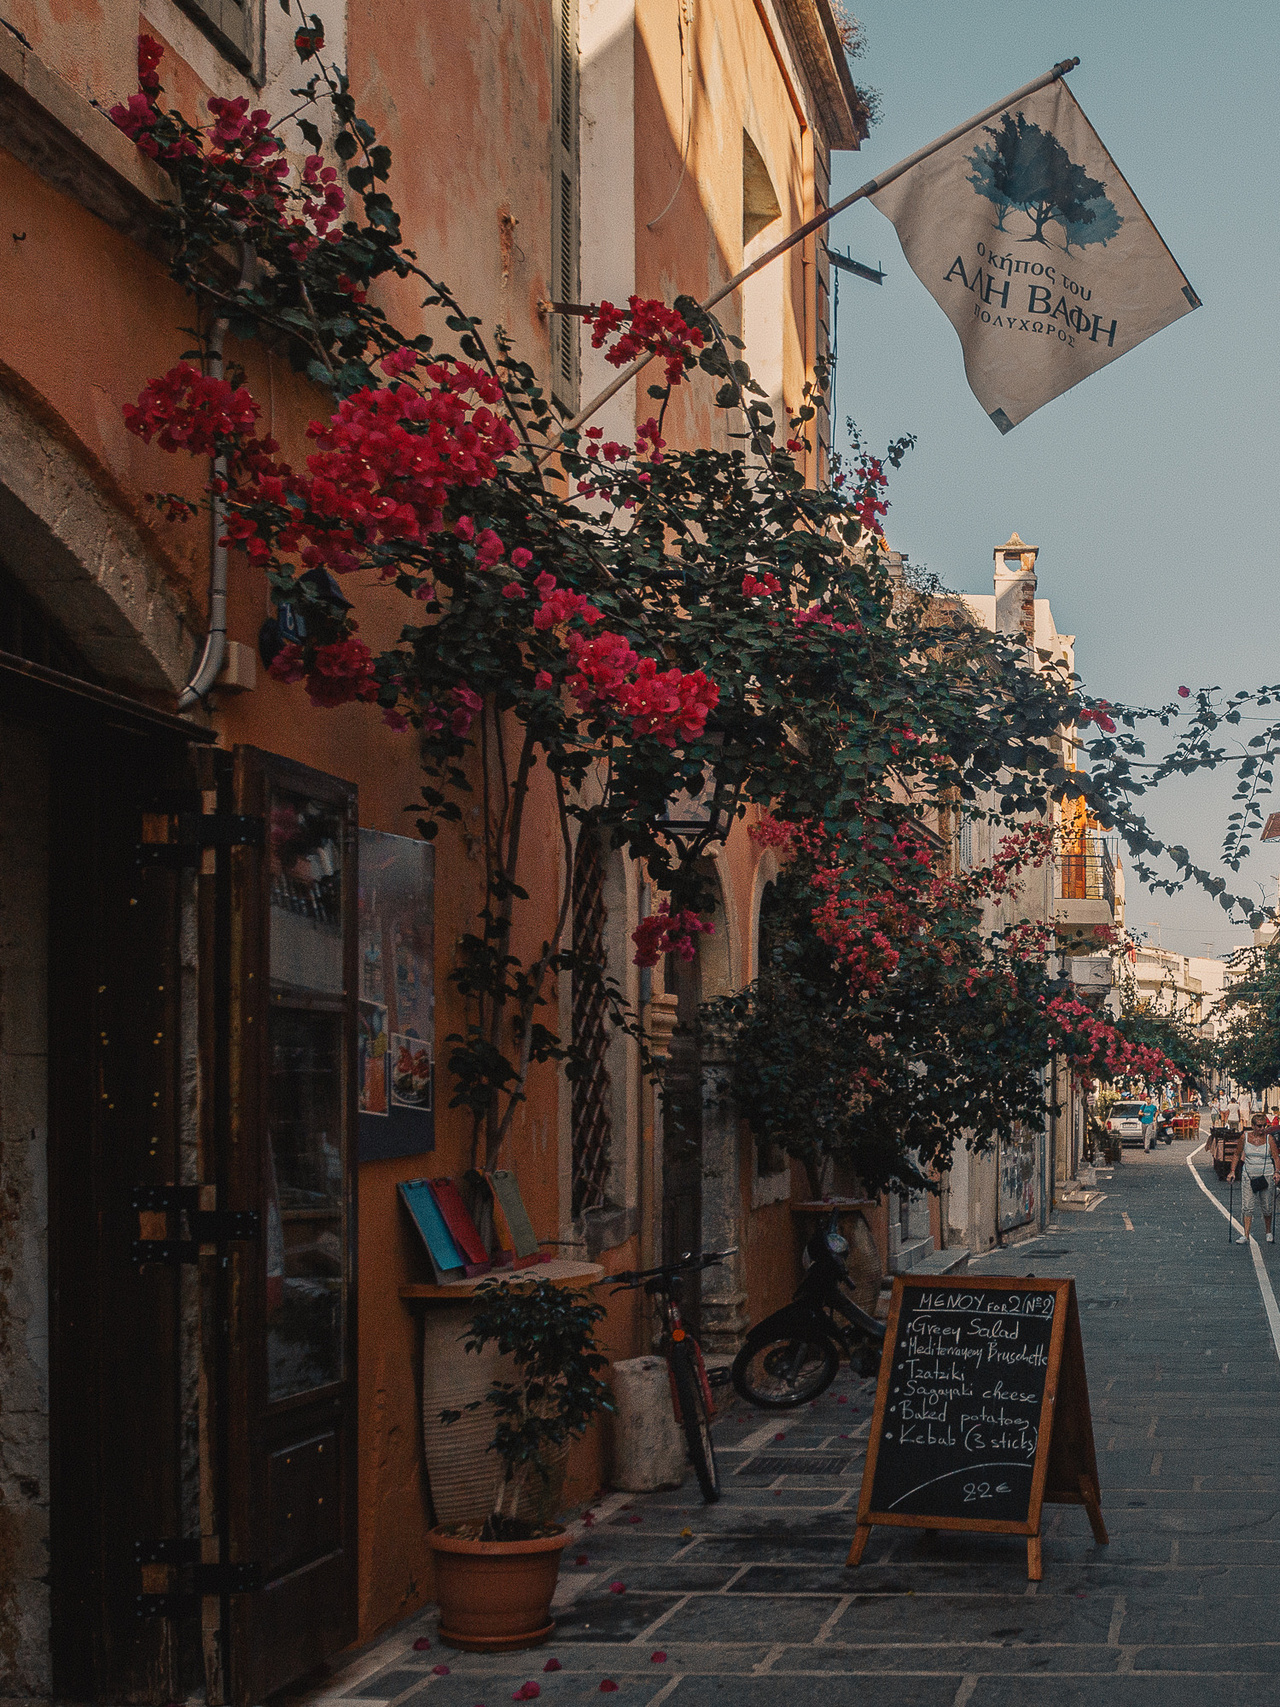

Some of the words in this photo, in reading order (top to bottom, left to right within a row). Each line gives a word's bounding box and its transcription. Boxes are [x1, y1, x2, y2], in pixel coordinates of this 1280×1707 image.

[987, 251, 1056, 285] κήπος
[1061, 273, 1092, 301] του
[943, 255, 1010, 309] ΑΛΗ
[1028, 284, 1118, 347] ΒΑΦΗ
[974, 303, 1075, 348] ΠΟΛΥΧΩΡΟΣ
[919, 1293, 985, 1311] MENOY
[967, 1318, 1019, 1339] Salad
[905, 1358, 965, 1381] Tzatziki
[982, 1380, 1038, 1403] cheese
[899, 1397, 947, 1421] Baked
[900, 1423, 956, 1446] Kebab
